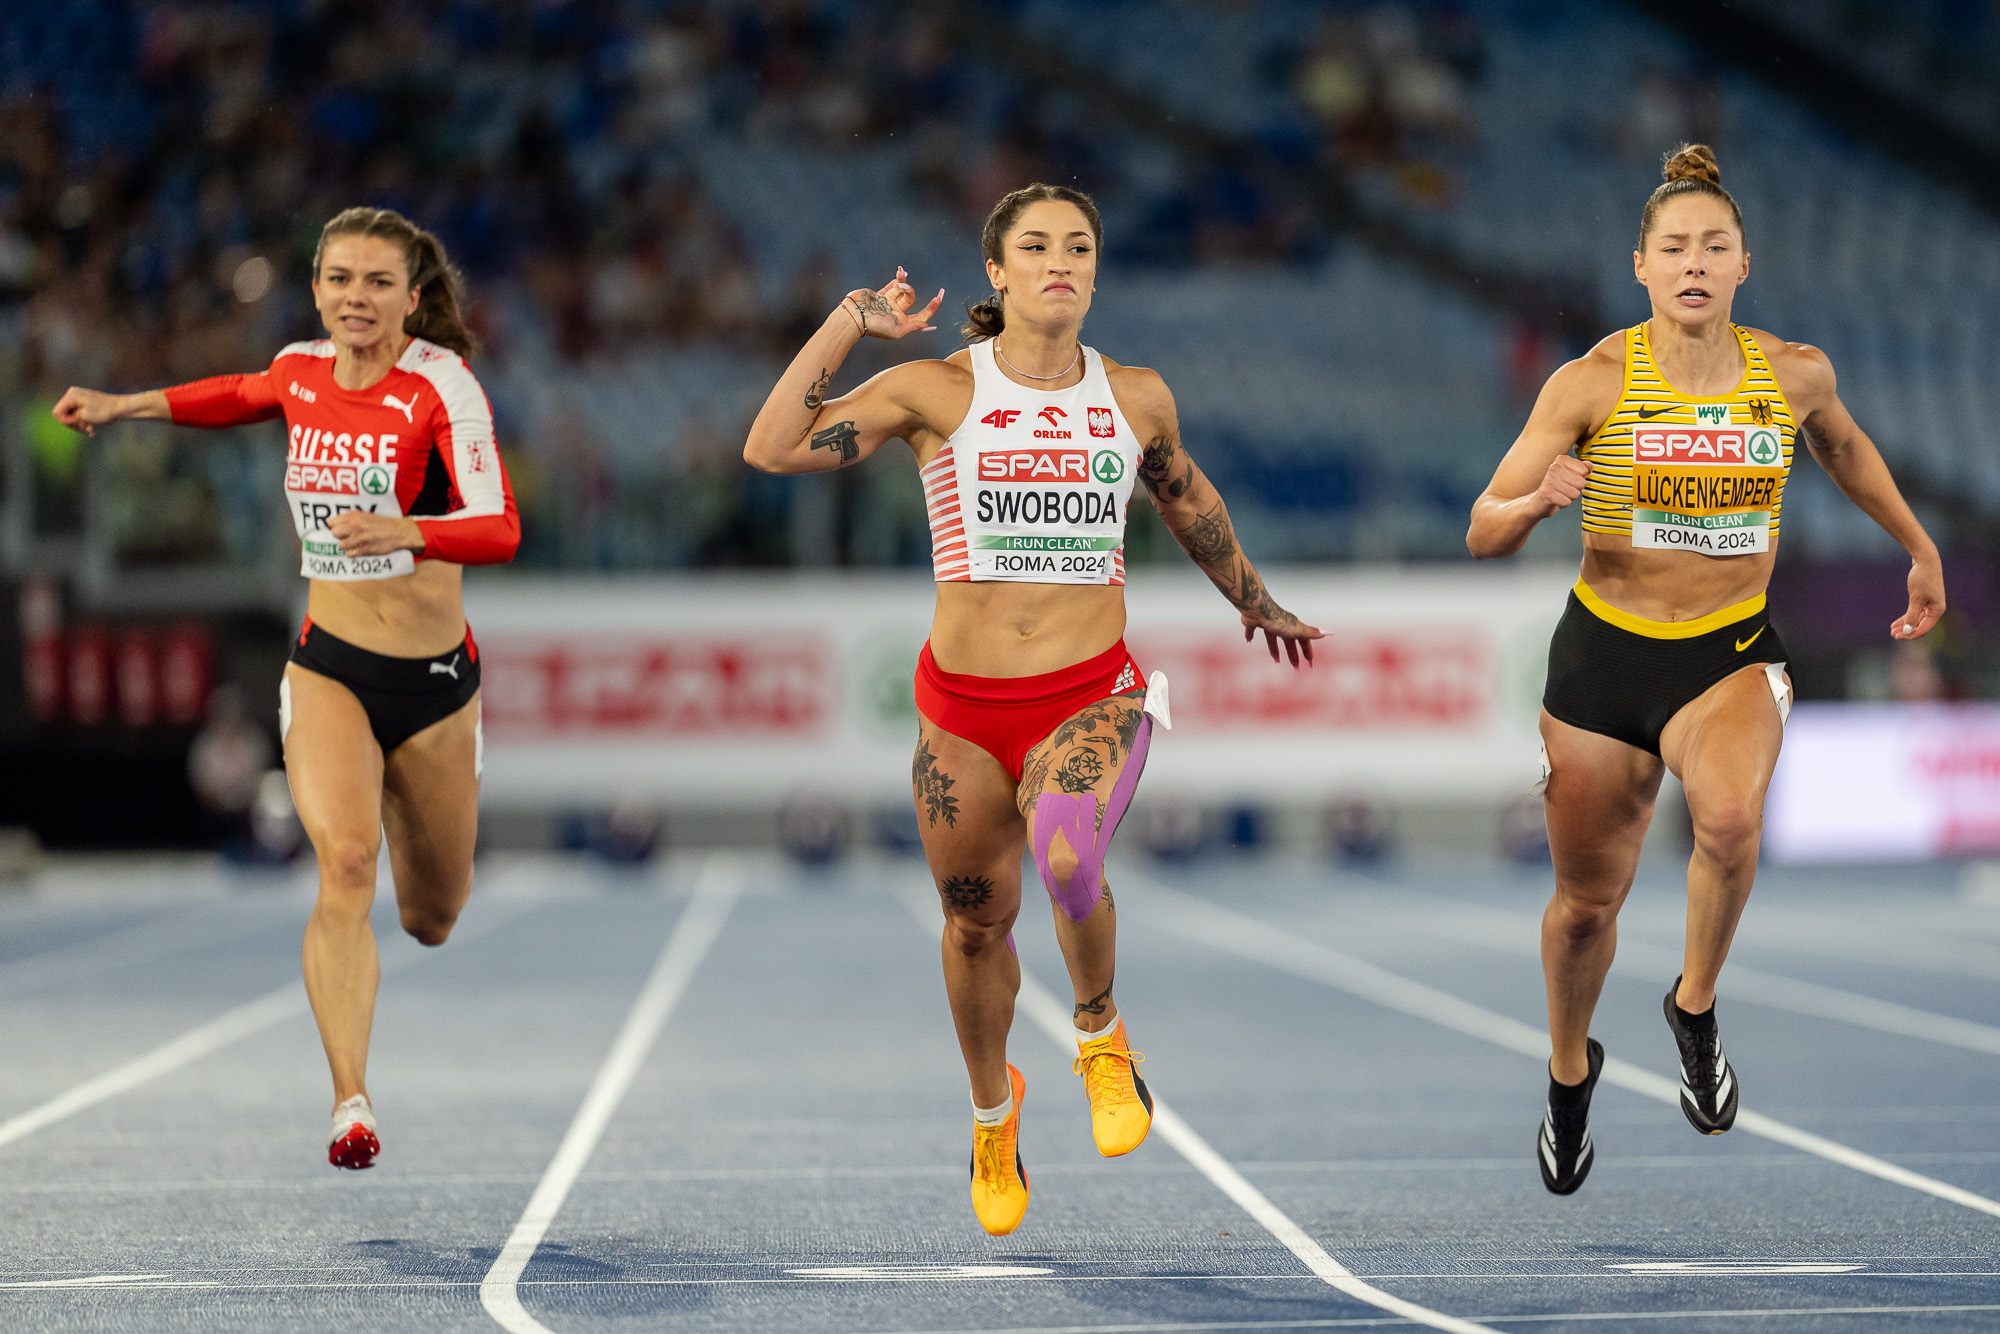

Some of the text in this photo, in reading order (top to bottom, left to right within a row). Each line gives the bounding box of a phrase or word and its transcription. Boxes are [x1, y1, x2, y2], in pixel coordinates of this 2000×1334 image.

[980, 409, 1022, 429] 4F
[1033, 429, 1072, 440] ORLEN
[1638, 433, 1743, 459] SPAR
[981, 453, 1087, 478] SPAR
[288, 467, 357, 493] SPAR
[1637, 469, 1776, 509] LÜCKENKEMPER
[976, 490, 1118, 524] SWOBODA
[1671, 514, 1701, 527] RUN
[1006, 538, 1010, 549] I
[1012, 538, 1044, 549] RUN
[1654, 528, 1756, 549] ROMA 2024
[352, 557, 393, 575] 2024
[995, 555, 1107, 573] ROMA 2024
